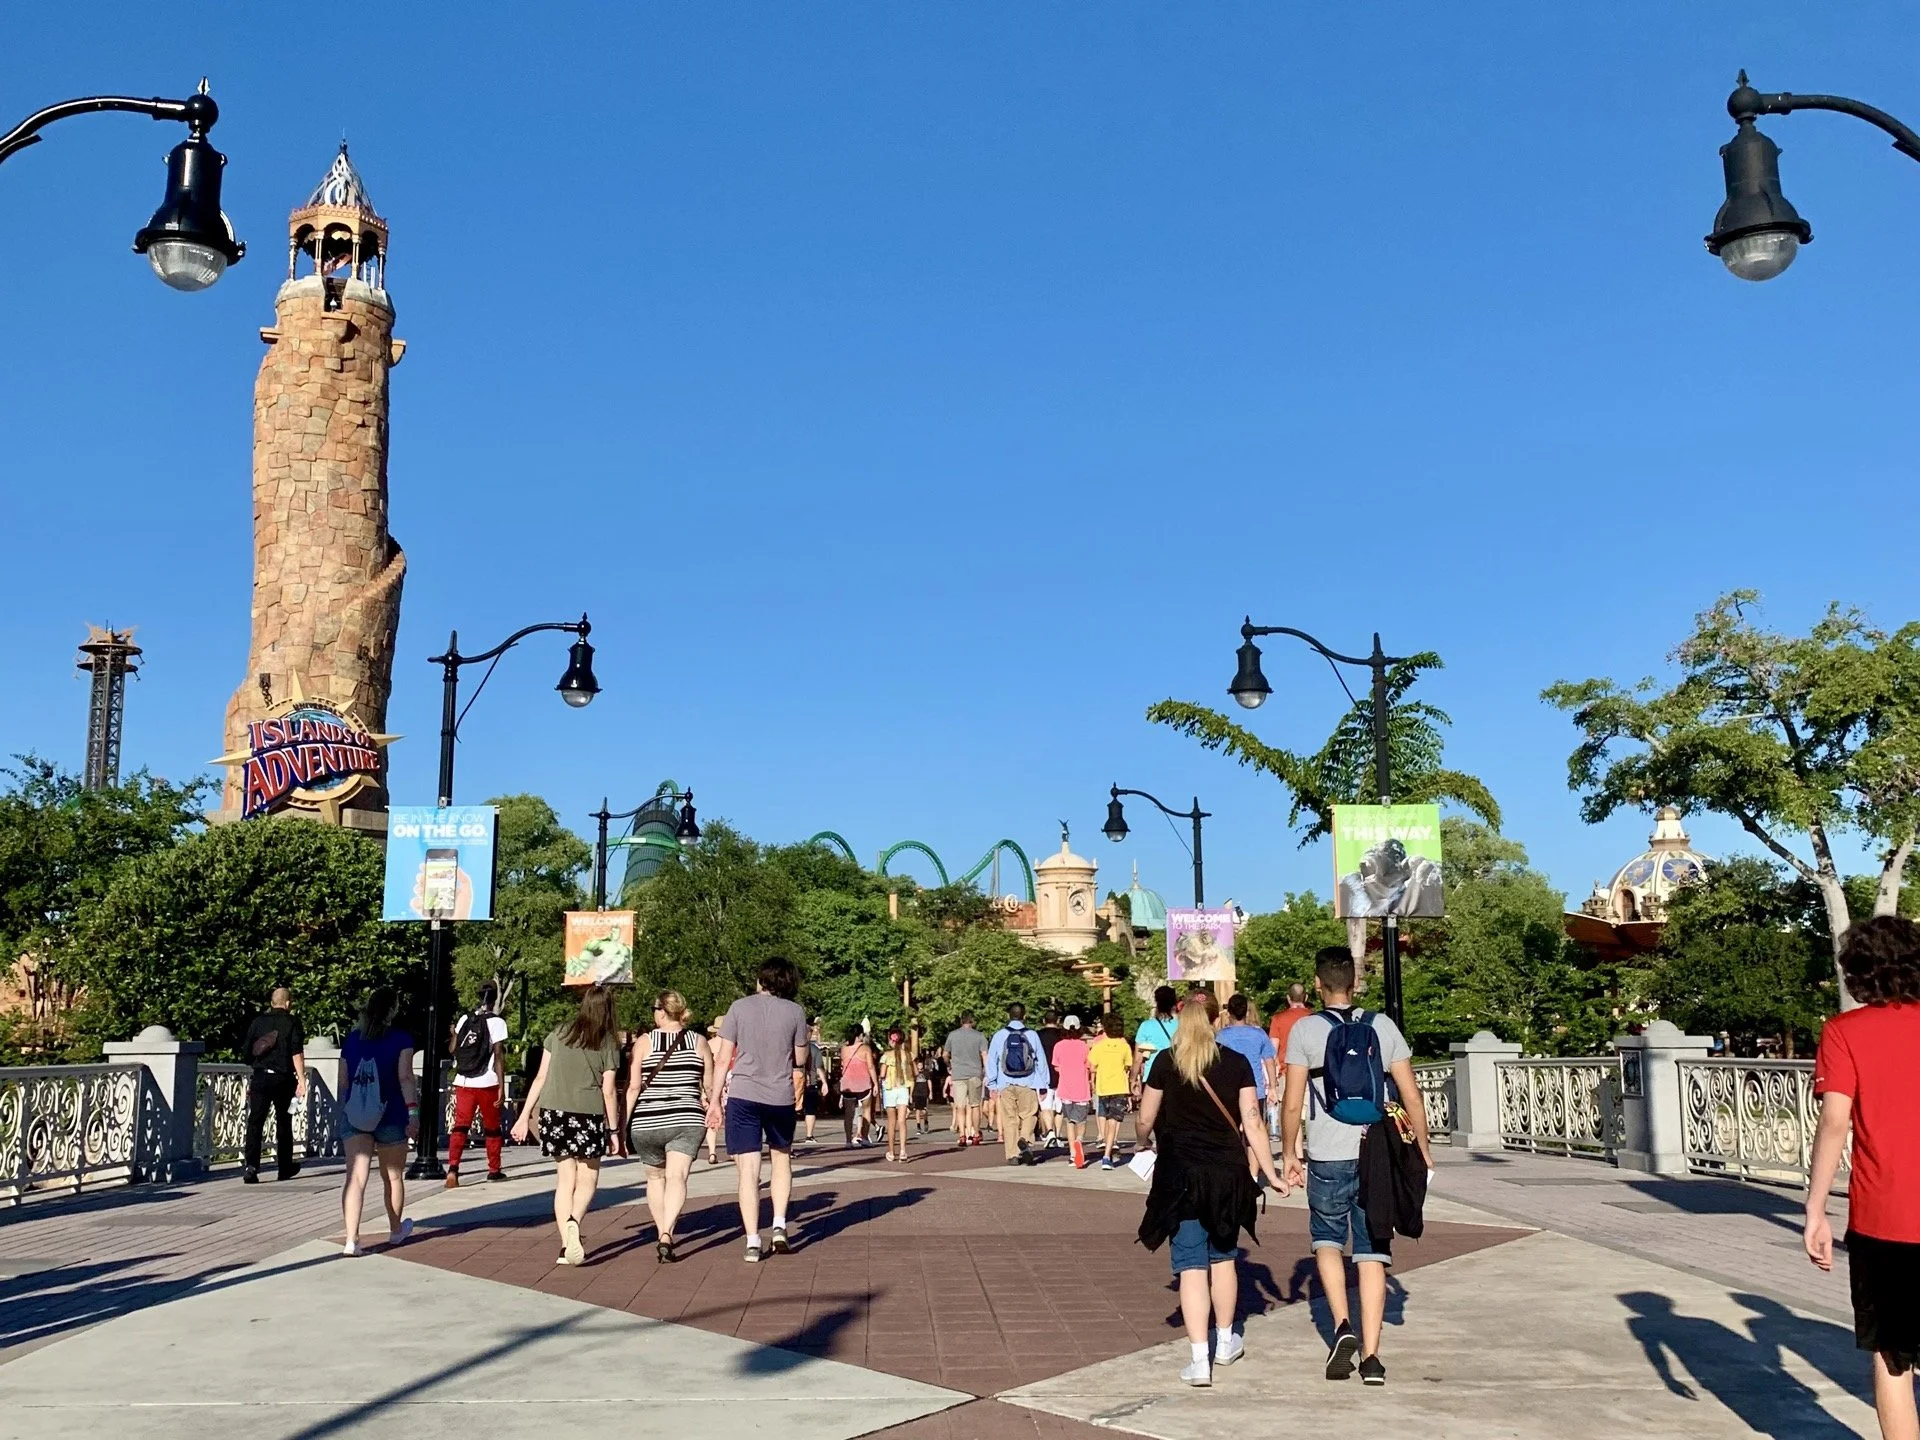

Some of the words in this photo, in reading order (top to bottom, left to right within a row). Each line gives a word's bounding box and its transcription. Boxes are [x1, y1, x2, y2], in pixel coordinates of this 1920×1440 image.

[251, 718, 353, 751] ISLANDS
[244, 743, 380, 816] ADVENTURE
[393, 813, 408, 824] BE
[411, 813, 422, 824] IN
[425, 813, 448, 824] THE
[449, 813, 485, 824] KNOW
[393, 824, 420, 838] ON
[422, 824, 457, 838] THE
[458, 824, 488, 838] GO.
[1342, 826, 1387, 841] THIS
[1171, 913, 1231, 923] WELCOME
